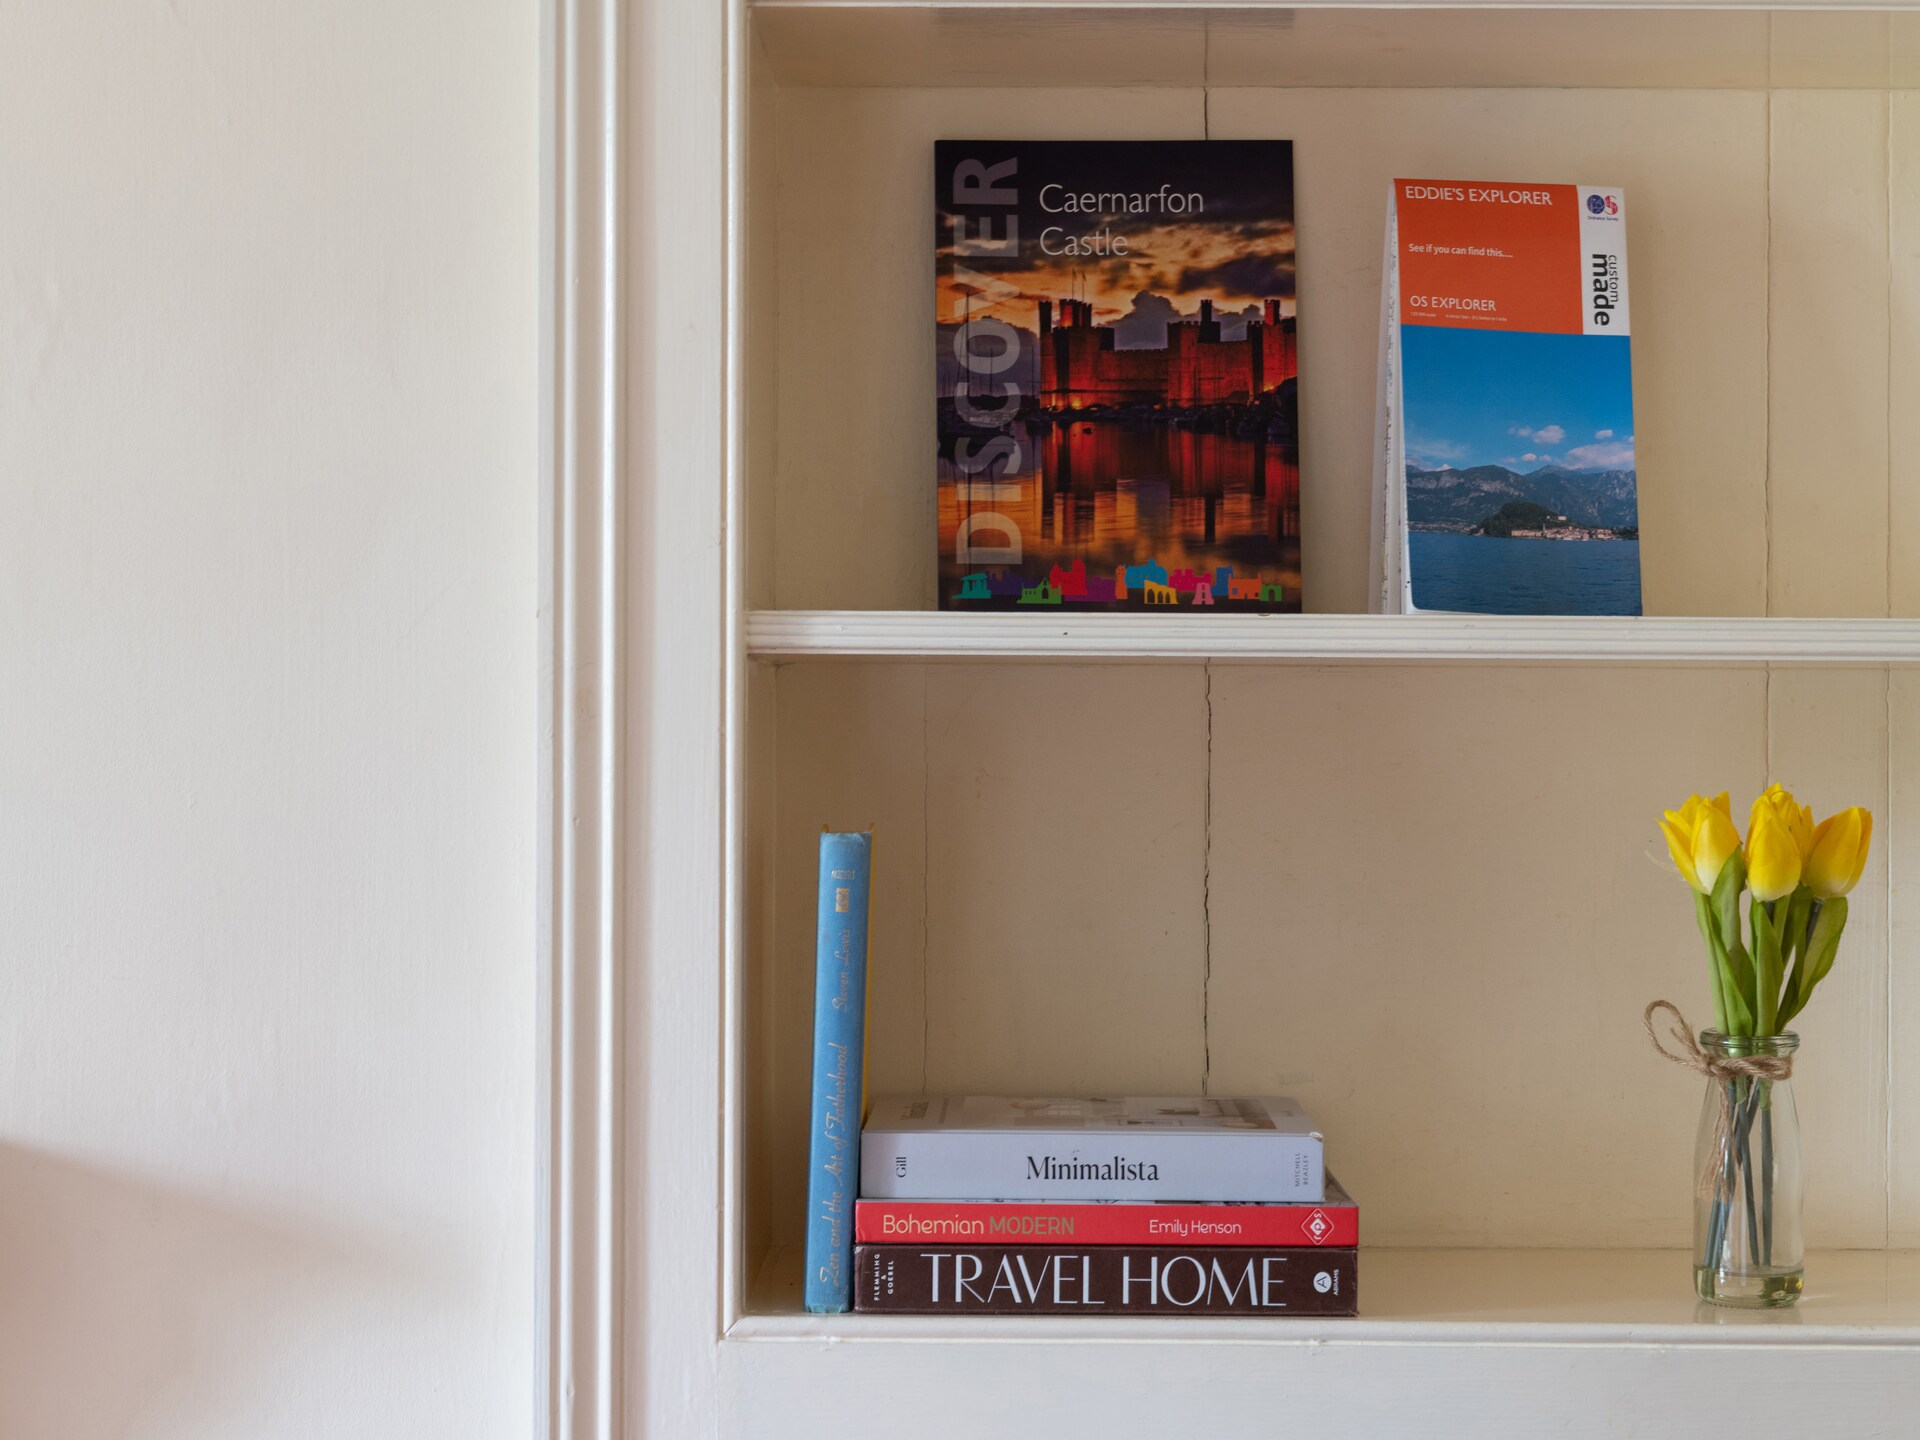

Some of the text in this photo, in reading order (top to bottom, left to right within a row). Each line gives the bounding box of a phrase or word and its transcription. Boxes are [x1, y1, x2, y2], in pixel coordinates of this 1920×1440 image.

[1039, 183, 1204, 213] Caernarfon
[1405, 185, 1553, 205] EDDIE'S EXPLORER
[1039, 226, 1129, 256] Castle
[1408, 243, 1424, 253] See
[1426, 244, 1432, 253] if
[1433, 246, 1450, 255] you
[1451, 247, 1467, 255] can
[1468, 244, 1485, 256] find
[1592, 253, 1615, 326] made
[1608, 254, 1619, 303] custom
[1410, 295, 1497, 311] OS EXPLORER
[953, 156, 1023, 567] DISCOVER
[831, 928, 850, 1012] Steven Lewis
[819, 1042, 848, 1288] Zen and the Art of Fatherhood
[896, 1156, 907, 1178] Gill
[1026, 1155, 1160, 1182] Minimalista
[882, 1213, 1074, 1235] Bohemian MODERN
[1149, 1219, 1241, 1238] Emily Henson
[920, 1253, 1287, 1306] TRAVEL HOME
